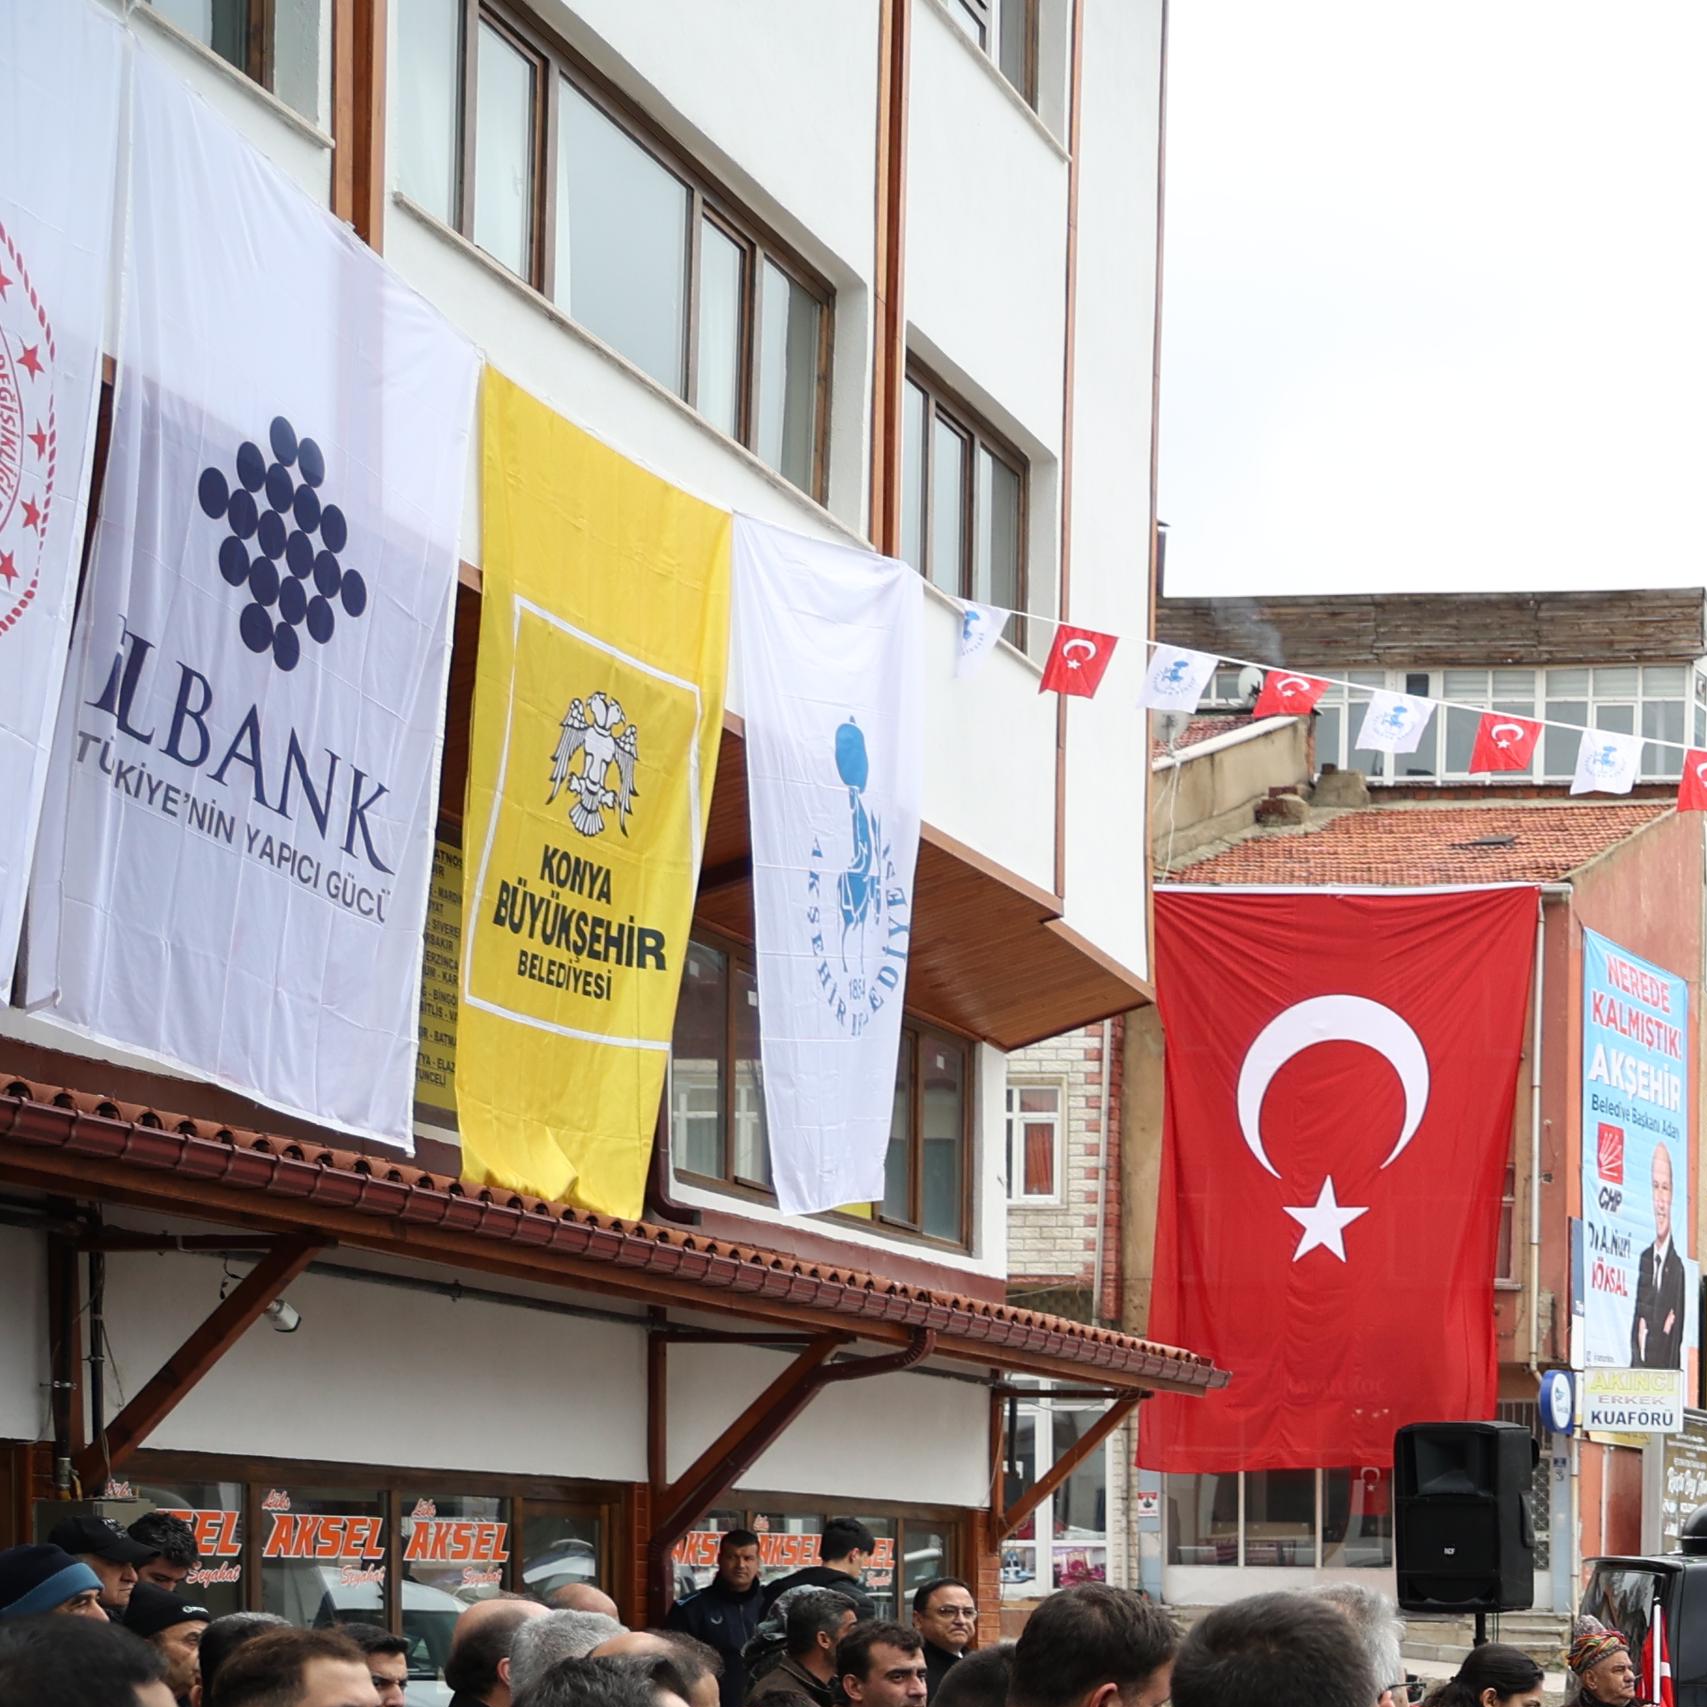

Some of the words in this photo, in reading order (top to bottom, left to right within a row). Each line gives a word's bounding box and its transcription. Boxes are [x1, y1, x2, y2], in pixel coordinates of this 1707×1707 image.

[76, 730, 238, 844] TÜKİYE'NİN
[245, 822, 322, 889] YAPICI
[540, 843, 612, 905] KONYA
[492, 875, 667, 972] BÜYÜKŞEHİR
[517, 949, 612, 1001] BELEDİYESİ
[1606, 954, 1671, 1014] NEREDE
[1591, 989, 1683, 1061] KALMIŞTIK!
[1588, 1043, 1681, 1113] AKŞEHİR
[1598, 1186, 1623, 1214] CHP
[1588, 1371, 1675, 1392] AKINCI
[1598, 1395, 1665, 1405] ERKEK
[1590, 1408, 1674, 1427] KUAFÖRÜ
[262, 1510, 387, 1561] AKSEL
[403, 1519, 511, 1563] AKSEL
